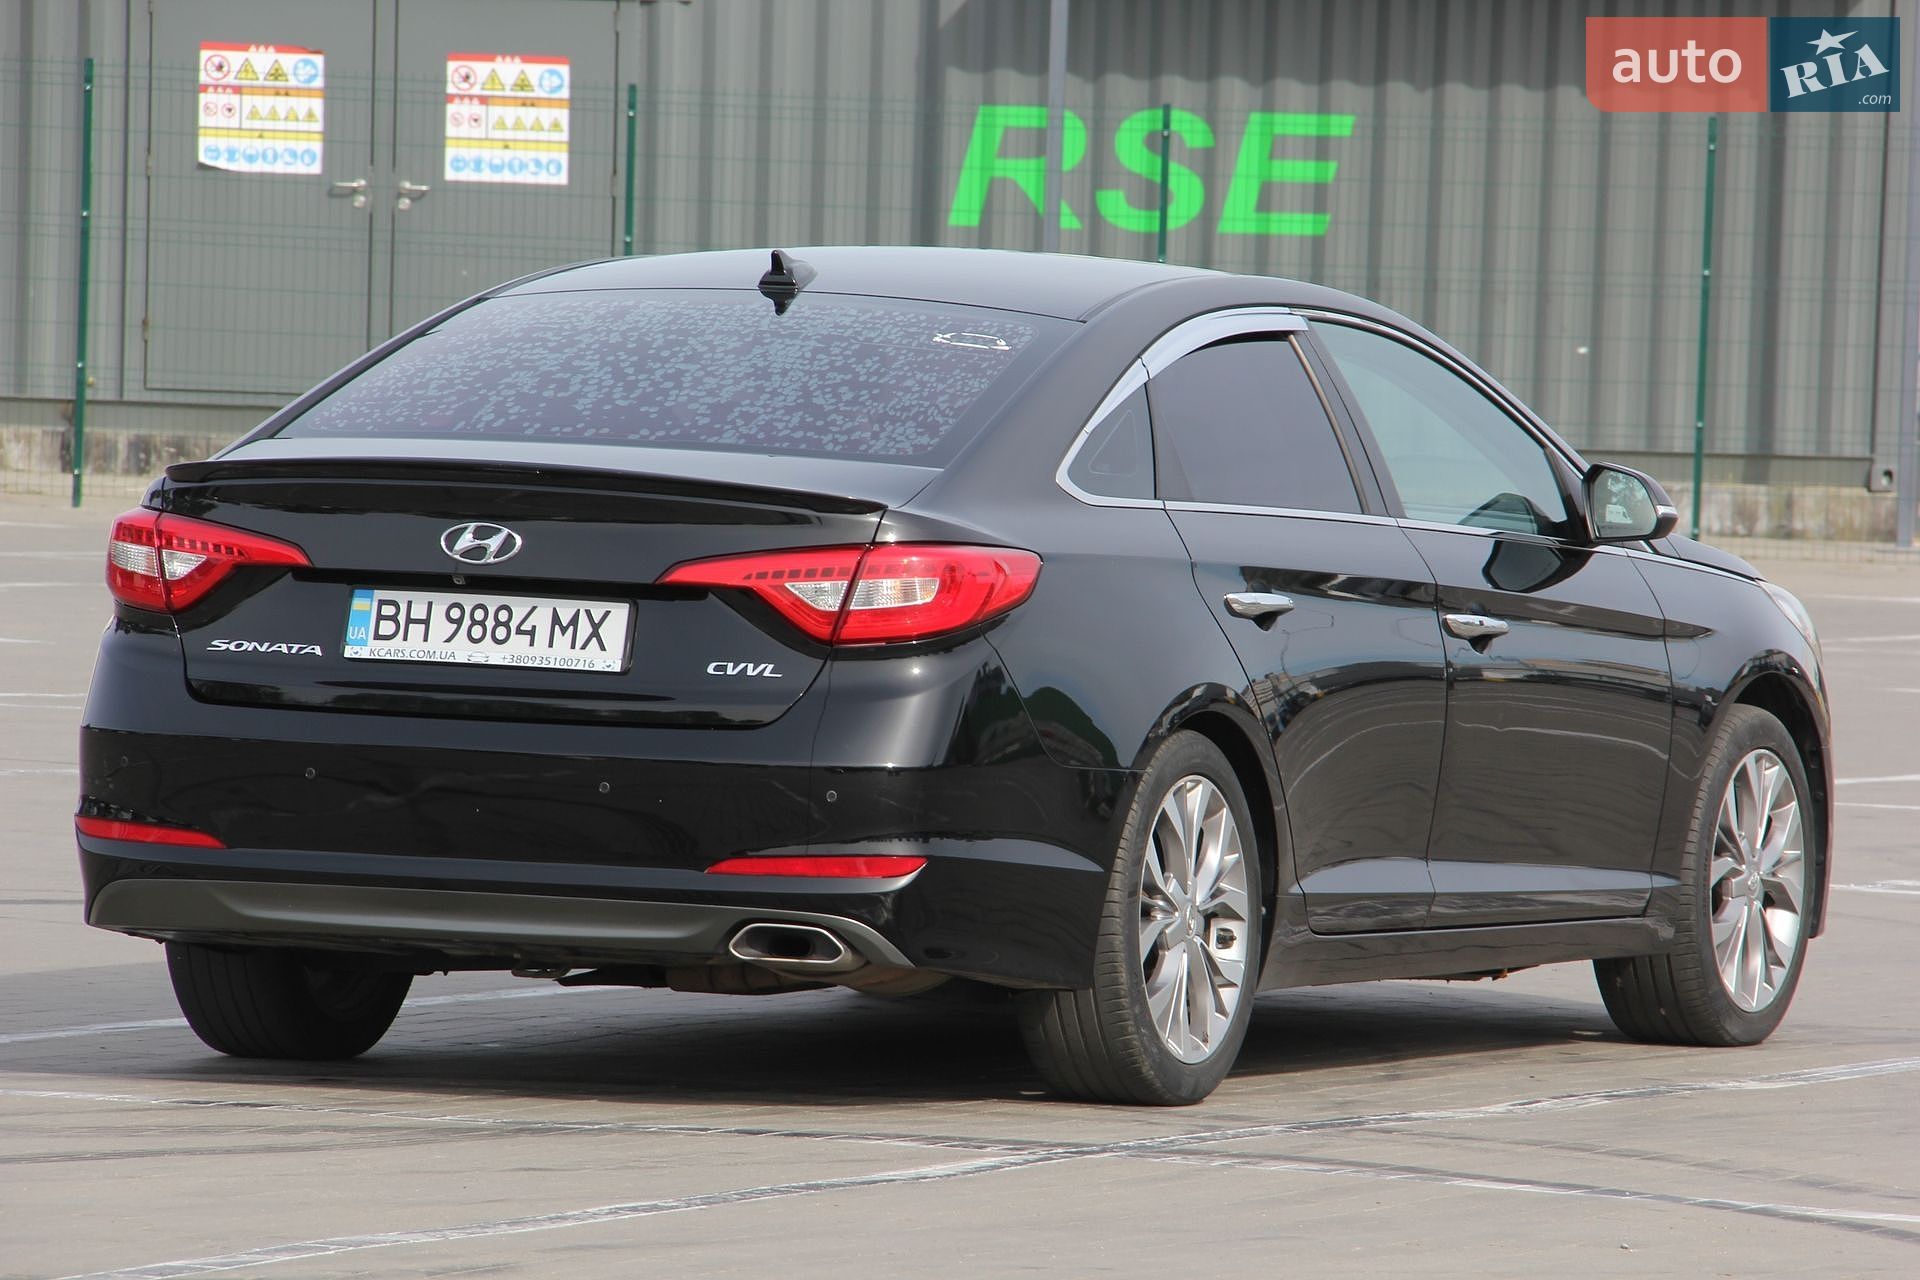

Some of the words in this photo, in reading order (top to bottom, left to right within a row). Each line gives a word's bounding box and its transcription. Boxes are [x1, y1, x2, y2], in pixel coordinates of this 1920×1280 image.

[947, 104, 1357, 236] RSE
[349, 626, 367, 641] UA
[372, 598, 433, 643] BH
[443, 601, 538, 648] 9884
[548, 606, 612, 652] MX
[206, 639, 323, 657] SONATA
[368, 647, 457, 661] KCARS.COM.UA
[501, 654, 596, 670] +380935100716
[706, 661, 783, 678] CVVL
